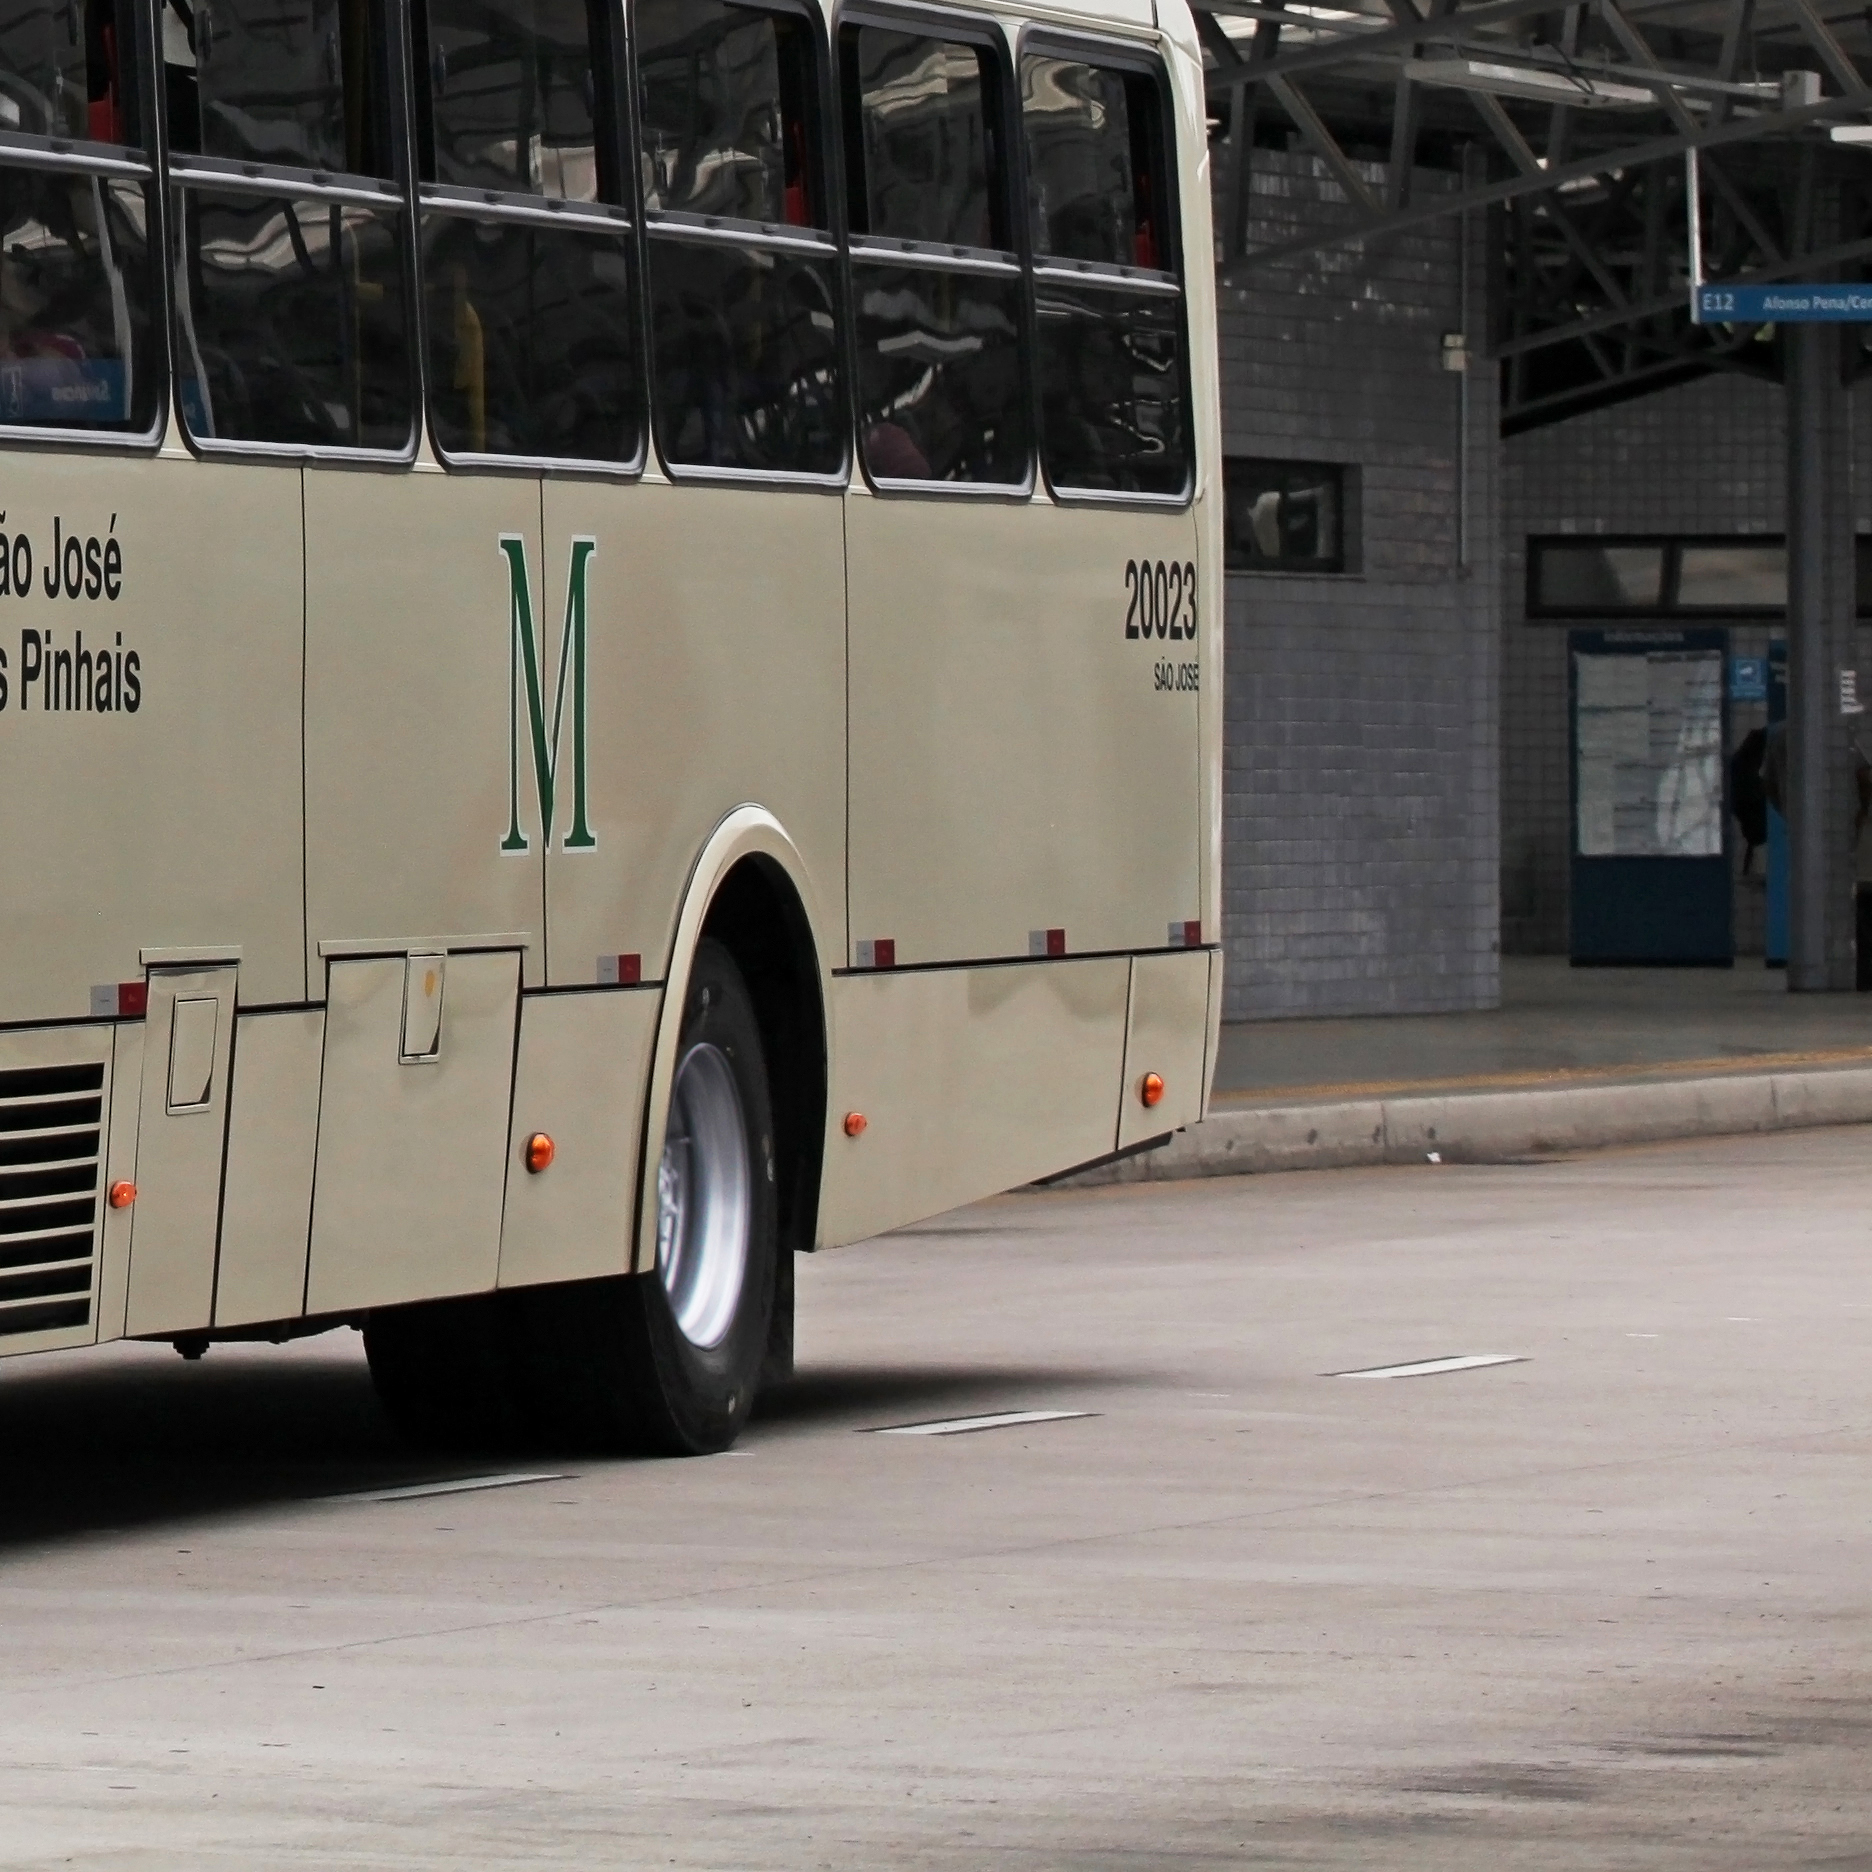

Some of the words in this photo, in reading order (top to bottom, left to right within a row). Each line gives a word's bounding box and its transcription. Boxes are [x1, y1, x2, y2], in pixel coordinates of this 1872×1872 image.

[1702, 293, 1735, 311] E12
[1762, 295, 1810, 311] Afonso
[43, 512, 122, 601] José
[1124, 558, 1197, 640] 20023
[20, 628, 141, 714] Pinhais
